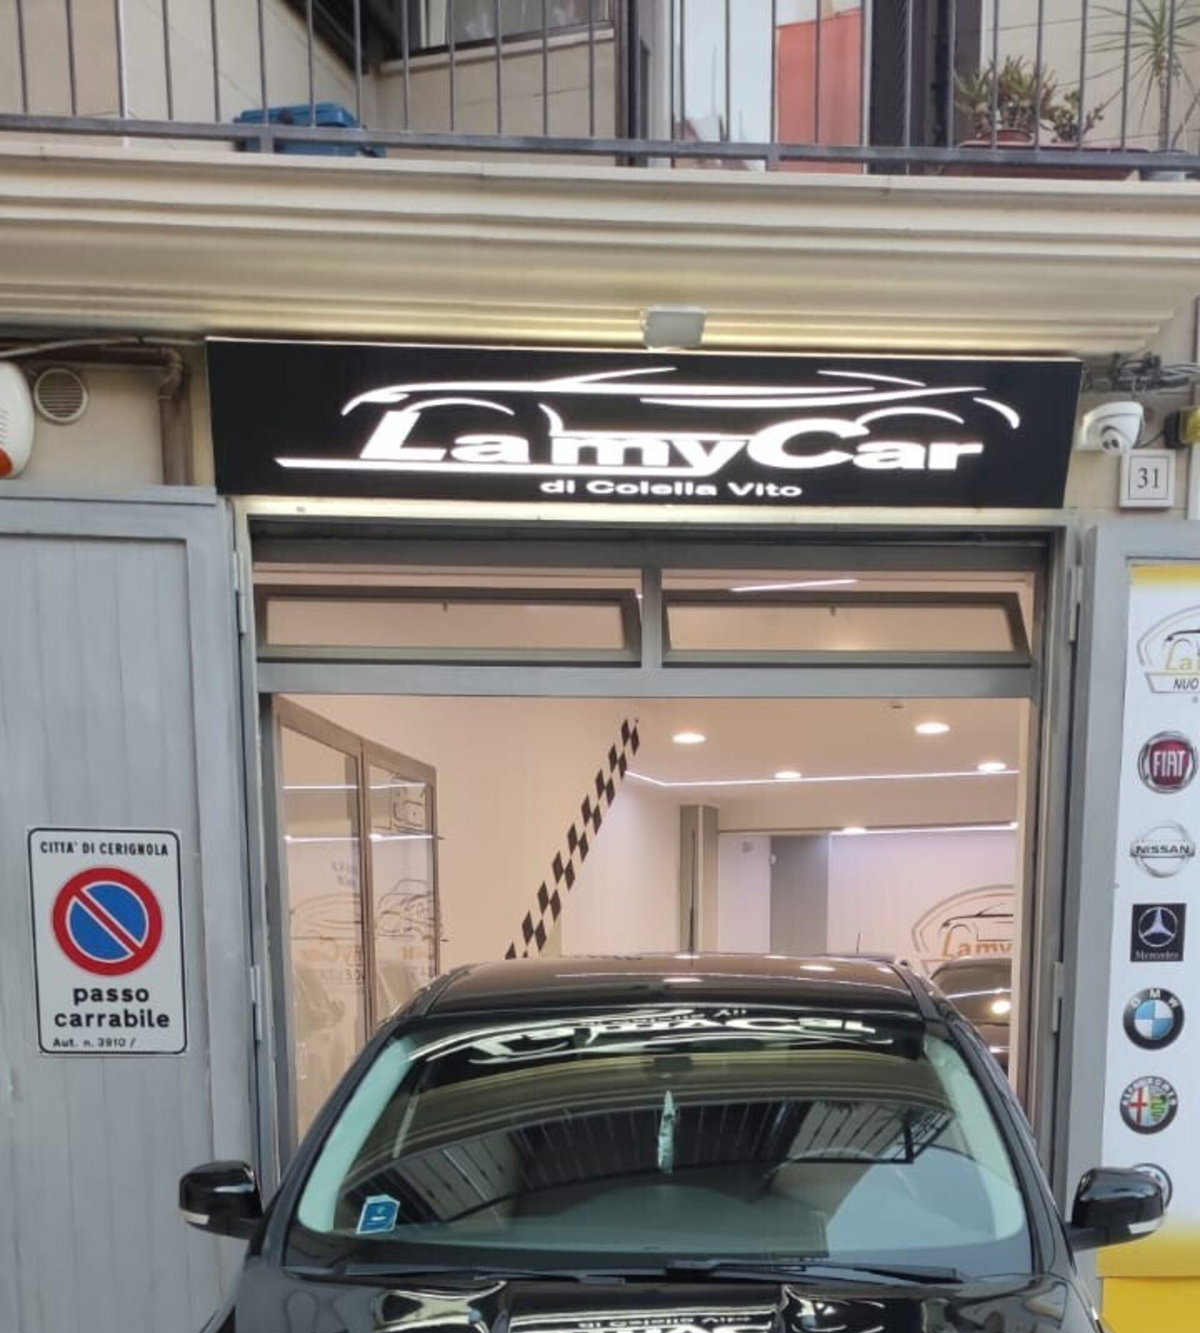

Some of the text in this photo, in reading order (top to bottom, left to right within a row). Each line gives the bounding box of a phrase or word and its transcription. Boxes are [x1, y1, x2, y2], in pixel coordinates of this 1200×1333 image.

[1137, 466, 1160, 489] 31
[540, 480, 802, 497] di Colella Vito
[1152, 750, 1187, 777] FIAT
[82, 842, 95, 854] DI
[99, 842, 169, 856] CERIGNOLA
[1136, 845, 1190, 854] NISSAN
[73, 987, 150, 1005] passo
[54, 1009, 171, 1028] carrabile
[53, 1038, 78, 1047] Aut.
